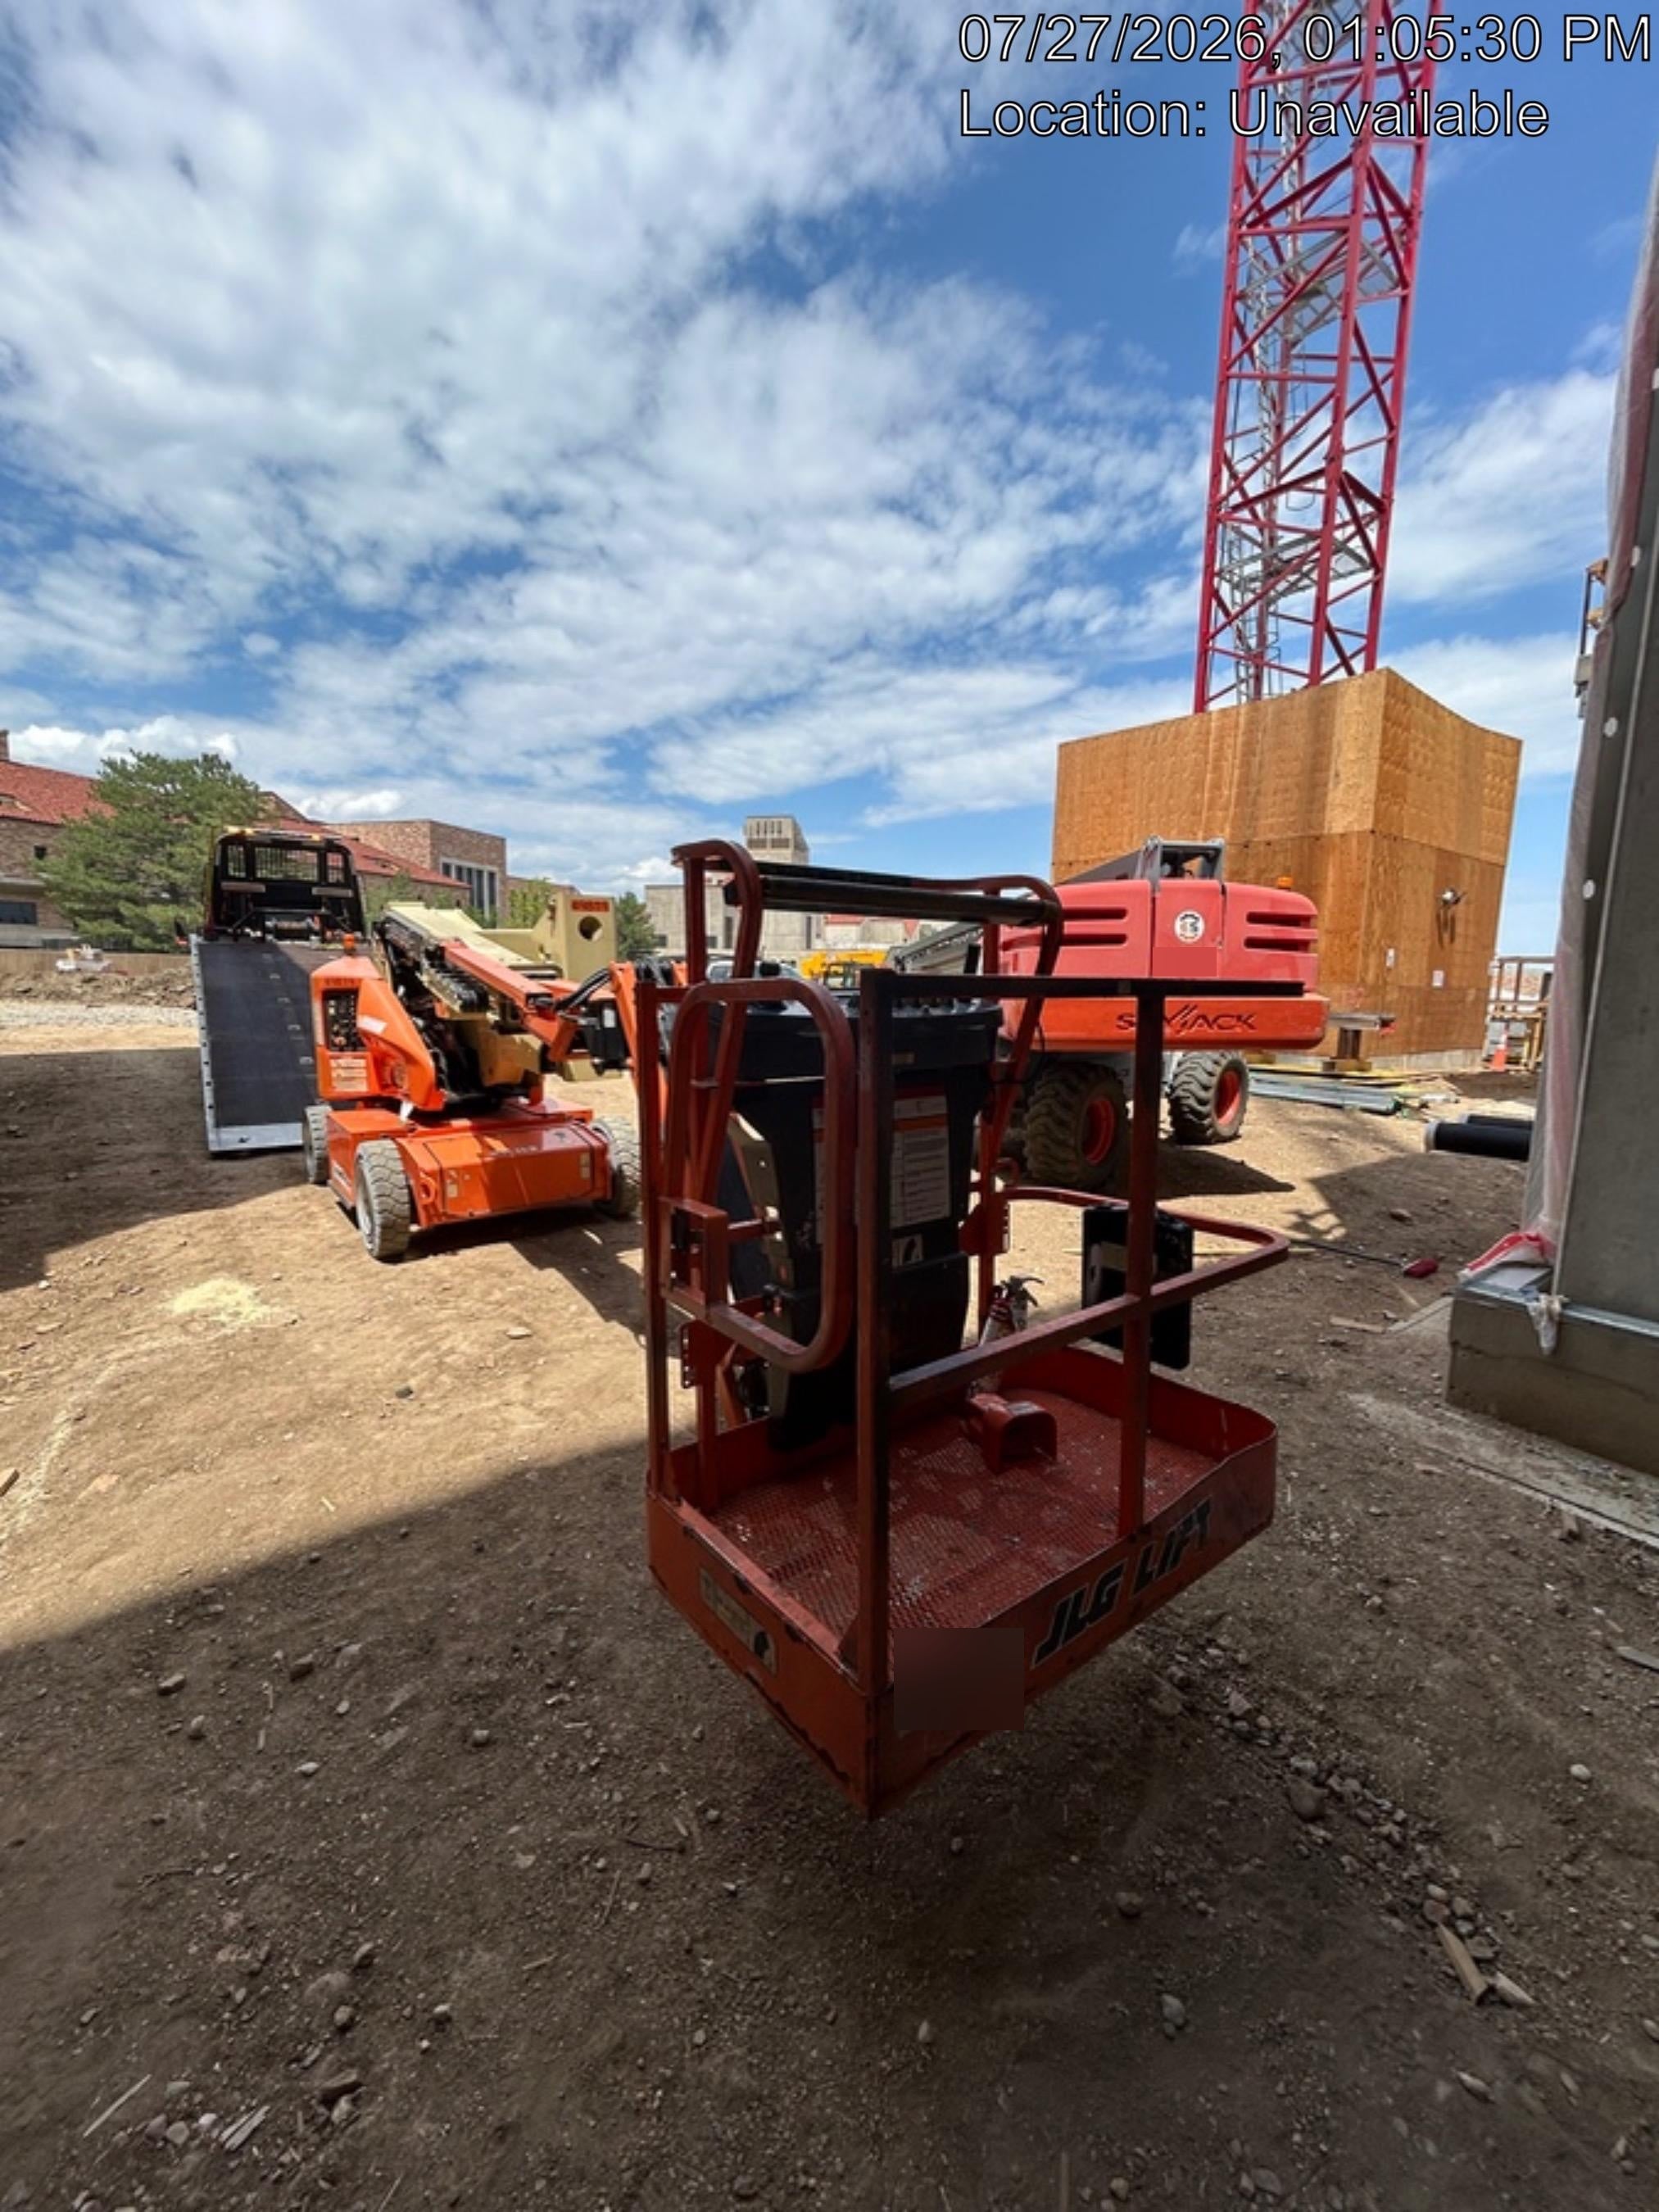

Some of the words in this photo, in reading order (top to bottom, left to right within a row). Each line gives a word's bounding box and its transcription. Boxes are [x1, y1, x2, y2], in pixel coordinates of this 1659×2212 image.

[1115, 1004, 1258, 1037] SYJACK
[1031, 1558, 1127, 1669] JLG
[1132, 1495, 1211, 1597] LIFT
